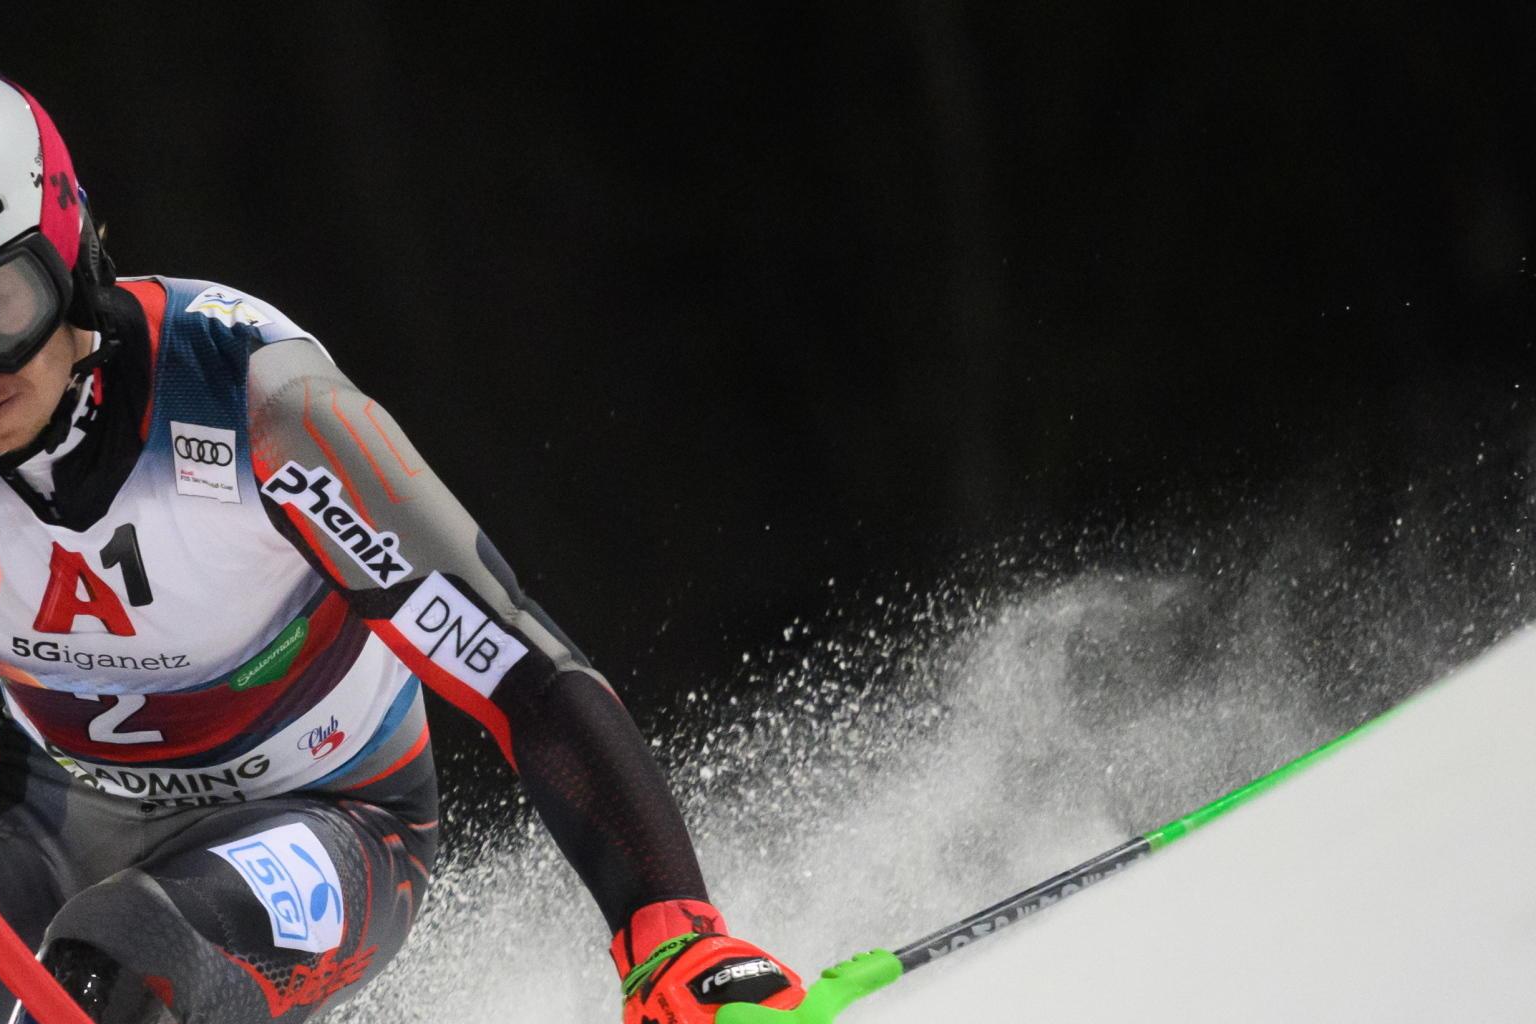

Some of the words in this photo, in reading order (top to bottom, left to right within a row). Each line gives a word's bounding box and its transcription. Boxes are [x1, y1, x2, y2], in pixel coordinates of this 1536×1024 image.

[265, 465, 406, 584] phenix
[33, 523, 153, 636] A1
[12, 637, 190, 671] 5Giganetz
[237, 626, 304, 687] Steiermark
[415, 596, 500, 675] DNB
[74, 693, 164, 744] 2
[297, 715, 339, 750] Club
[93, 754, 270, 797] ADMING
[246, 857, 300, 924] 5G
